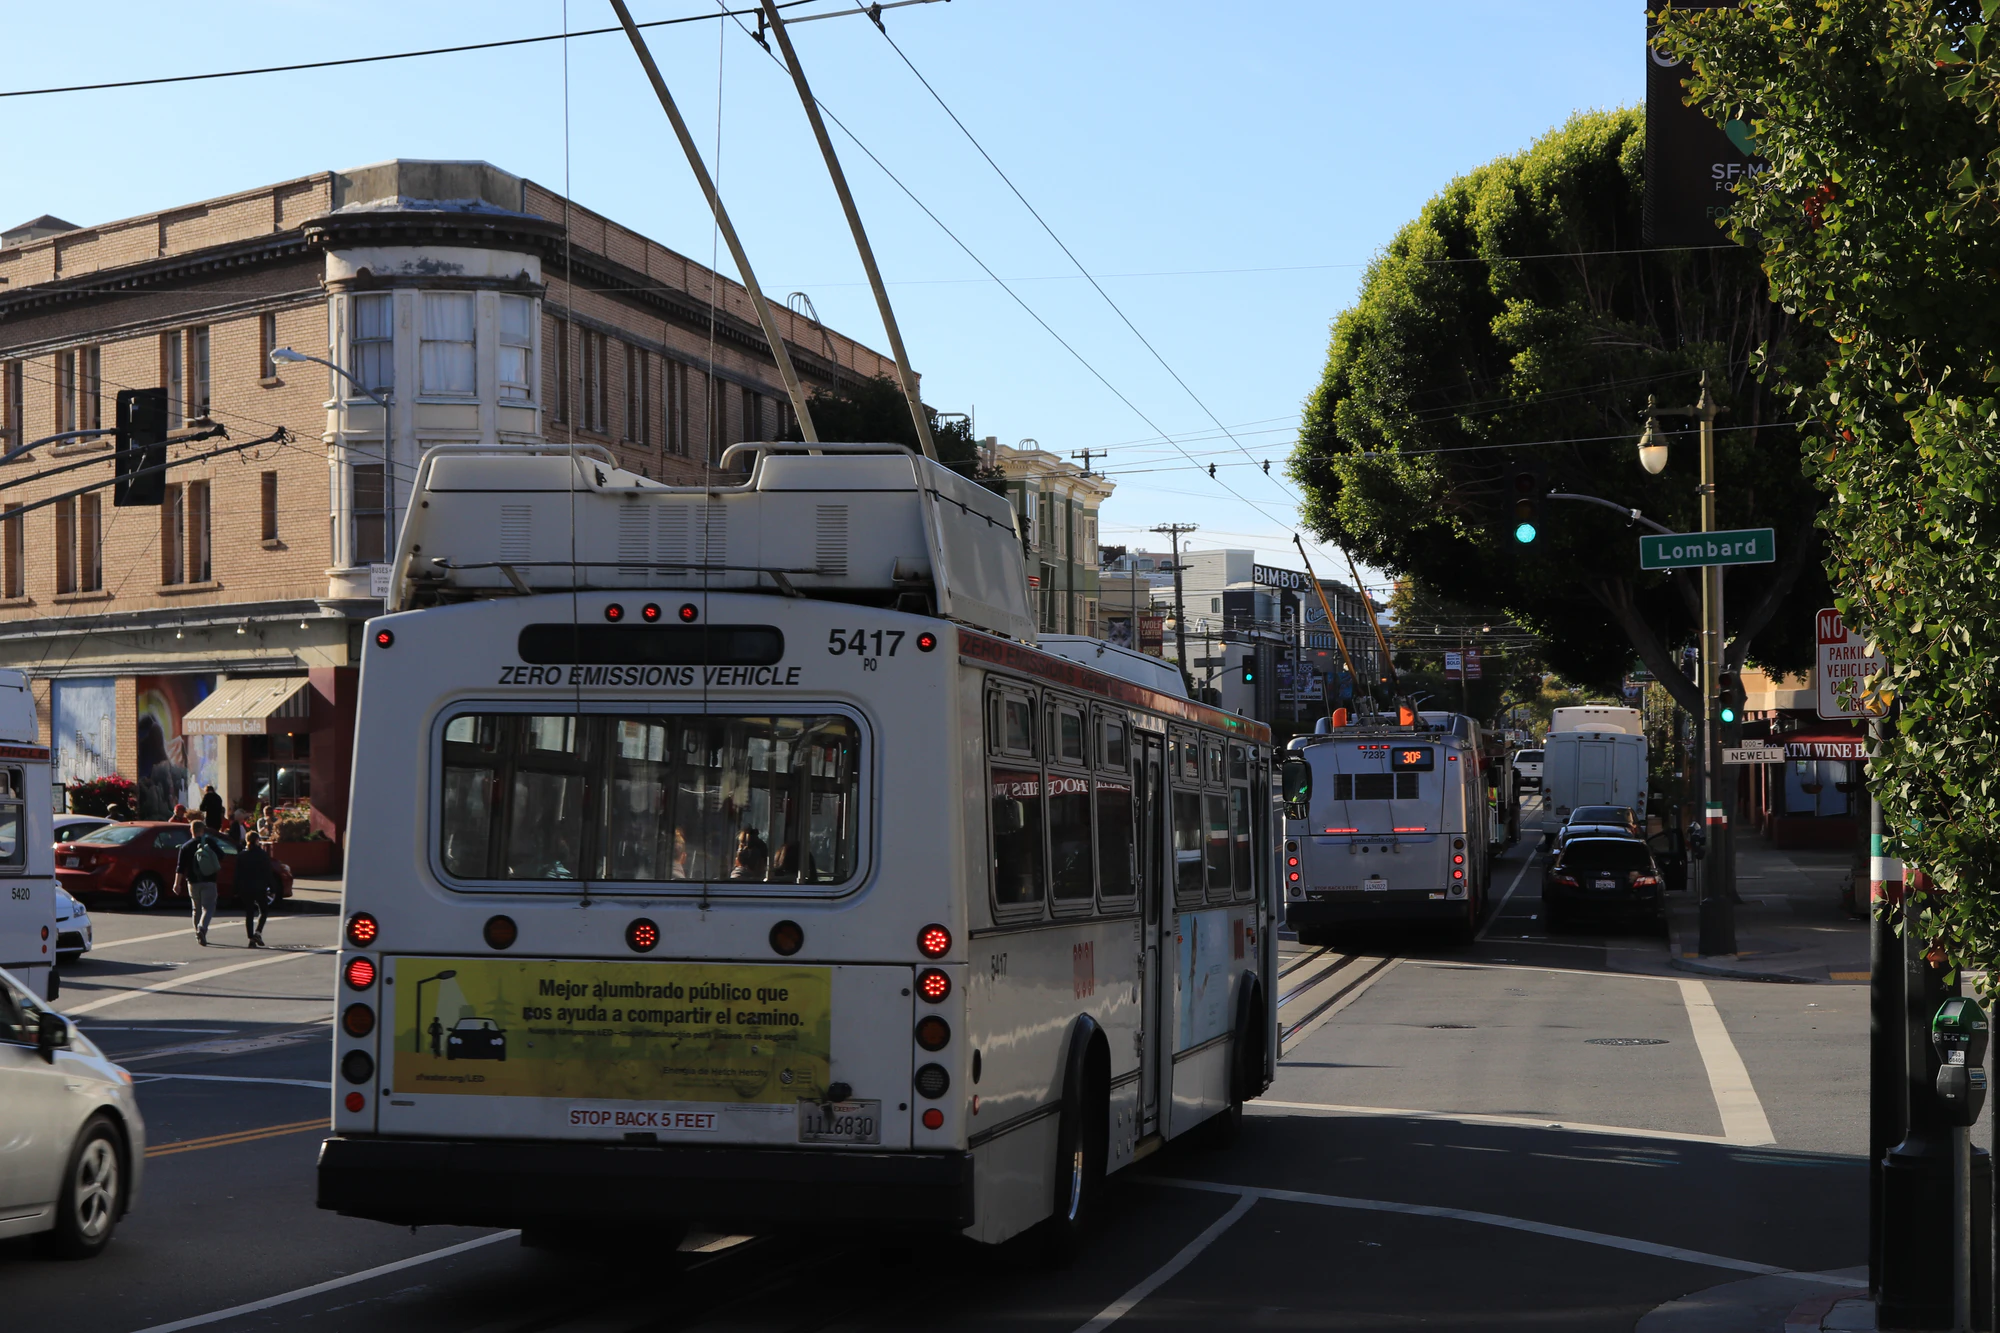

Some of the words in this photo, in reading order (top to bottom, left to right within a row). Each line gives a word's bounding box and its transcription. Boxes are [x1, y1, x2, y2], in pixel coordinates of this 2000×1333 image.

[1658, 538, 1756, 560] Lombard
[1141, 620, 1161, 628] WOLF
[1821, 615, 1843, 639] NO
[827, 628, 905, 656] 5417
[864, 658, 877, 671] PO
[962, 633, 1002, 661] ZERO
[1005, 648, 1075, 684] EMISSIONS
[499, 666, 561, 685] ZERO
[568, 667, 694, 686] EMISSIONS
[703, 667, 801, 686] VEHICLE
[1827, 663, 1878, 677] VEHICLES
[1831, 681, 1858, 695] OR
[188, 720, 200, 732] 901
[203, 721, 241, 732] Columbus
[242, 720, 261, 732] Cafe
[1731, 752, 1777, 760] NEWELL
[1783, 743, 1811, 758] ATM
[1813, 744, 1851, 758] WINE
[12, 888, 30, 900] 5420
[539, 979, 588, 1001] Mejor
[592, 980, 684, 1000] alumbrado
[688, 981, 751, 1003] público
[756, 987, 788, 1004] que
[556, 1004, 607, 1024] ayuda
[612, 1008, 622, 1022] a
[627, 1007, 712, 1027] compartir
[715, 1007, 731, 1024] el
[735, 1008, 804, 1027] camino.
[698, 1067, 709, 1075] de
[711, 1068, 736, 1076] Hetch
[738, 1069, 767, 1078] Hetchy
[570, 1110, 609, 1126] STOP
[615, 1111, 657, 1127] BACK
[661, 1112, 670, 1127] 5
[675, 1113, 714, 1129] FEET
[806, 1116, 873, 1135] 1116830
